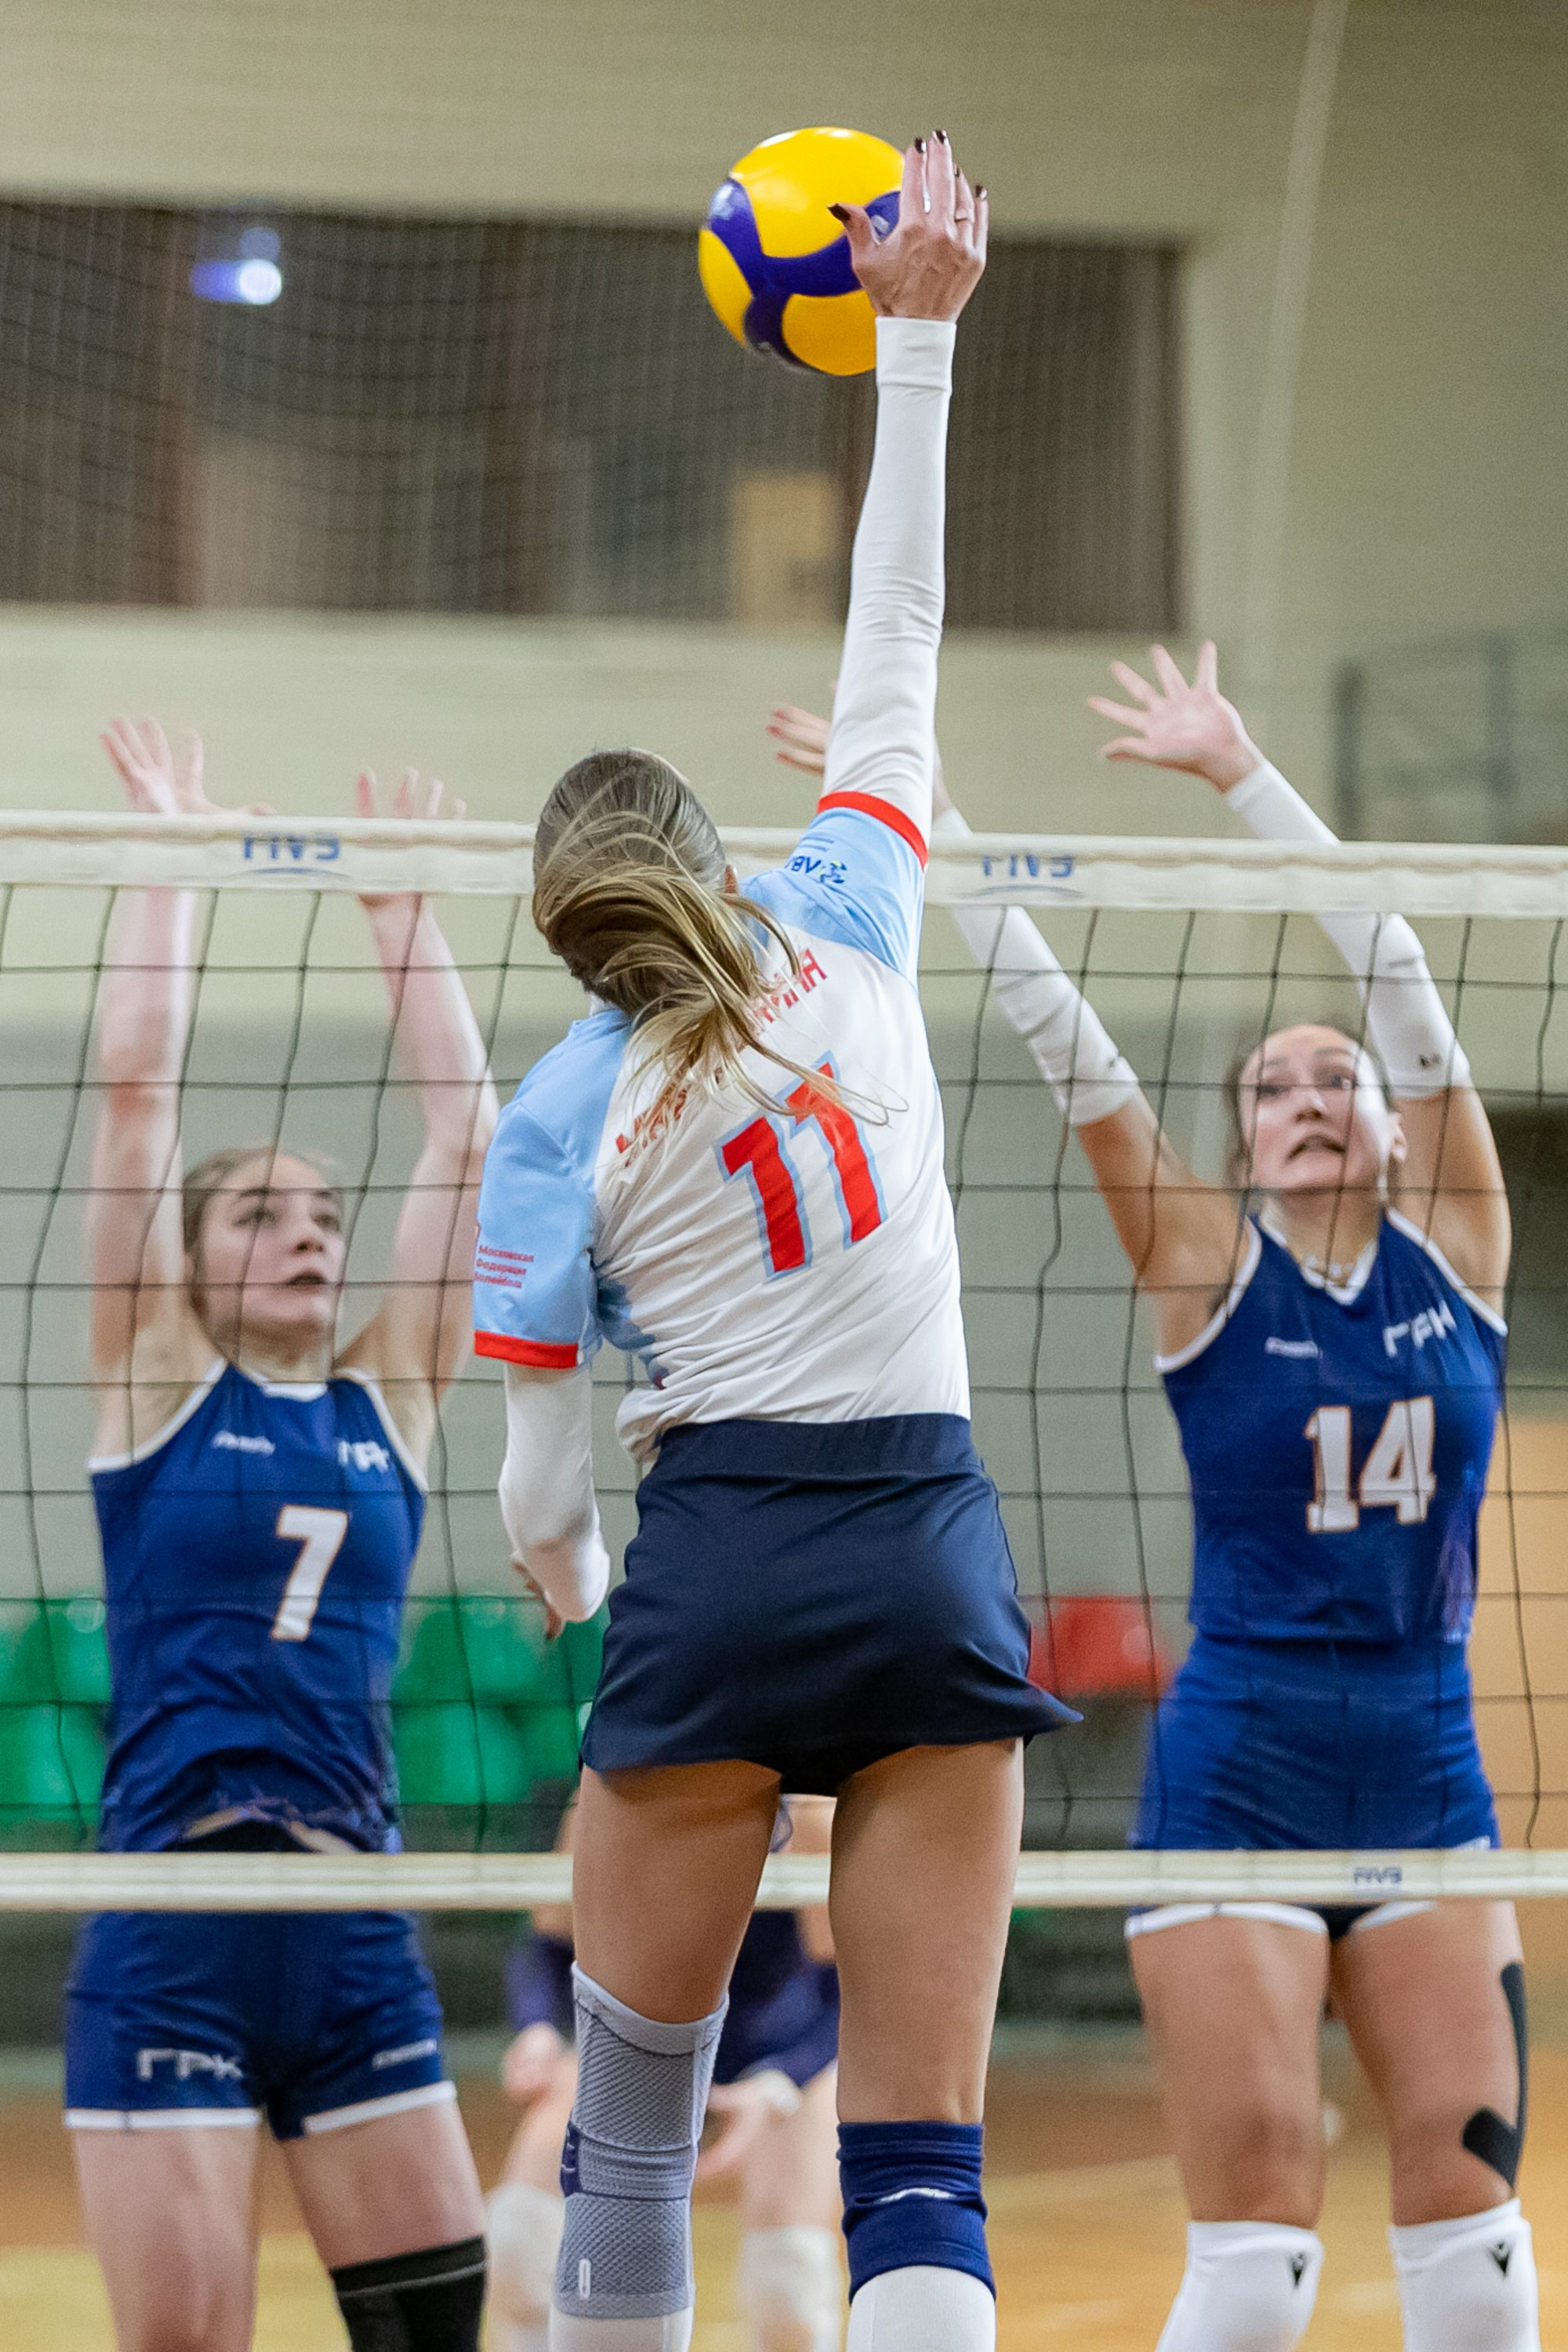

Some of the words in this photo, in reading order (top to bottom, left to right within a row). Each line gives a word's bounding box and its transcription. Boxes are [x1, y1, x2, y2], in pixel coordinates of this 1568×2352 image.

[718, 1054, 887, 1278] 11
[1303, 1395, 1437, 1533] 14
[270, 1503, 350, 1642] 7
